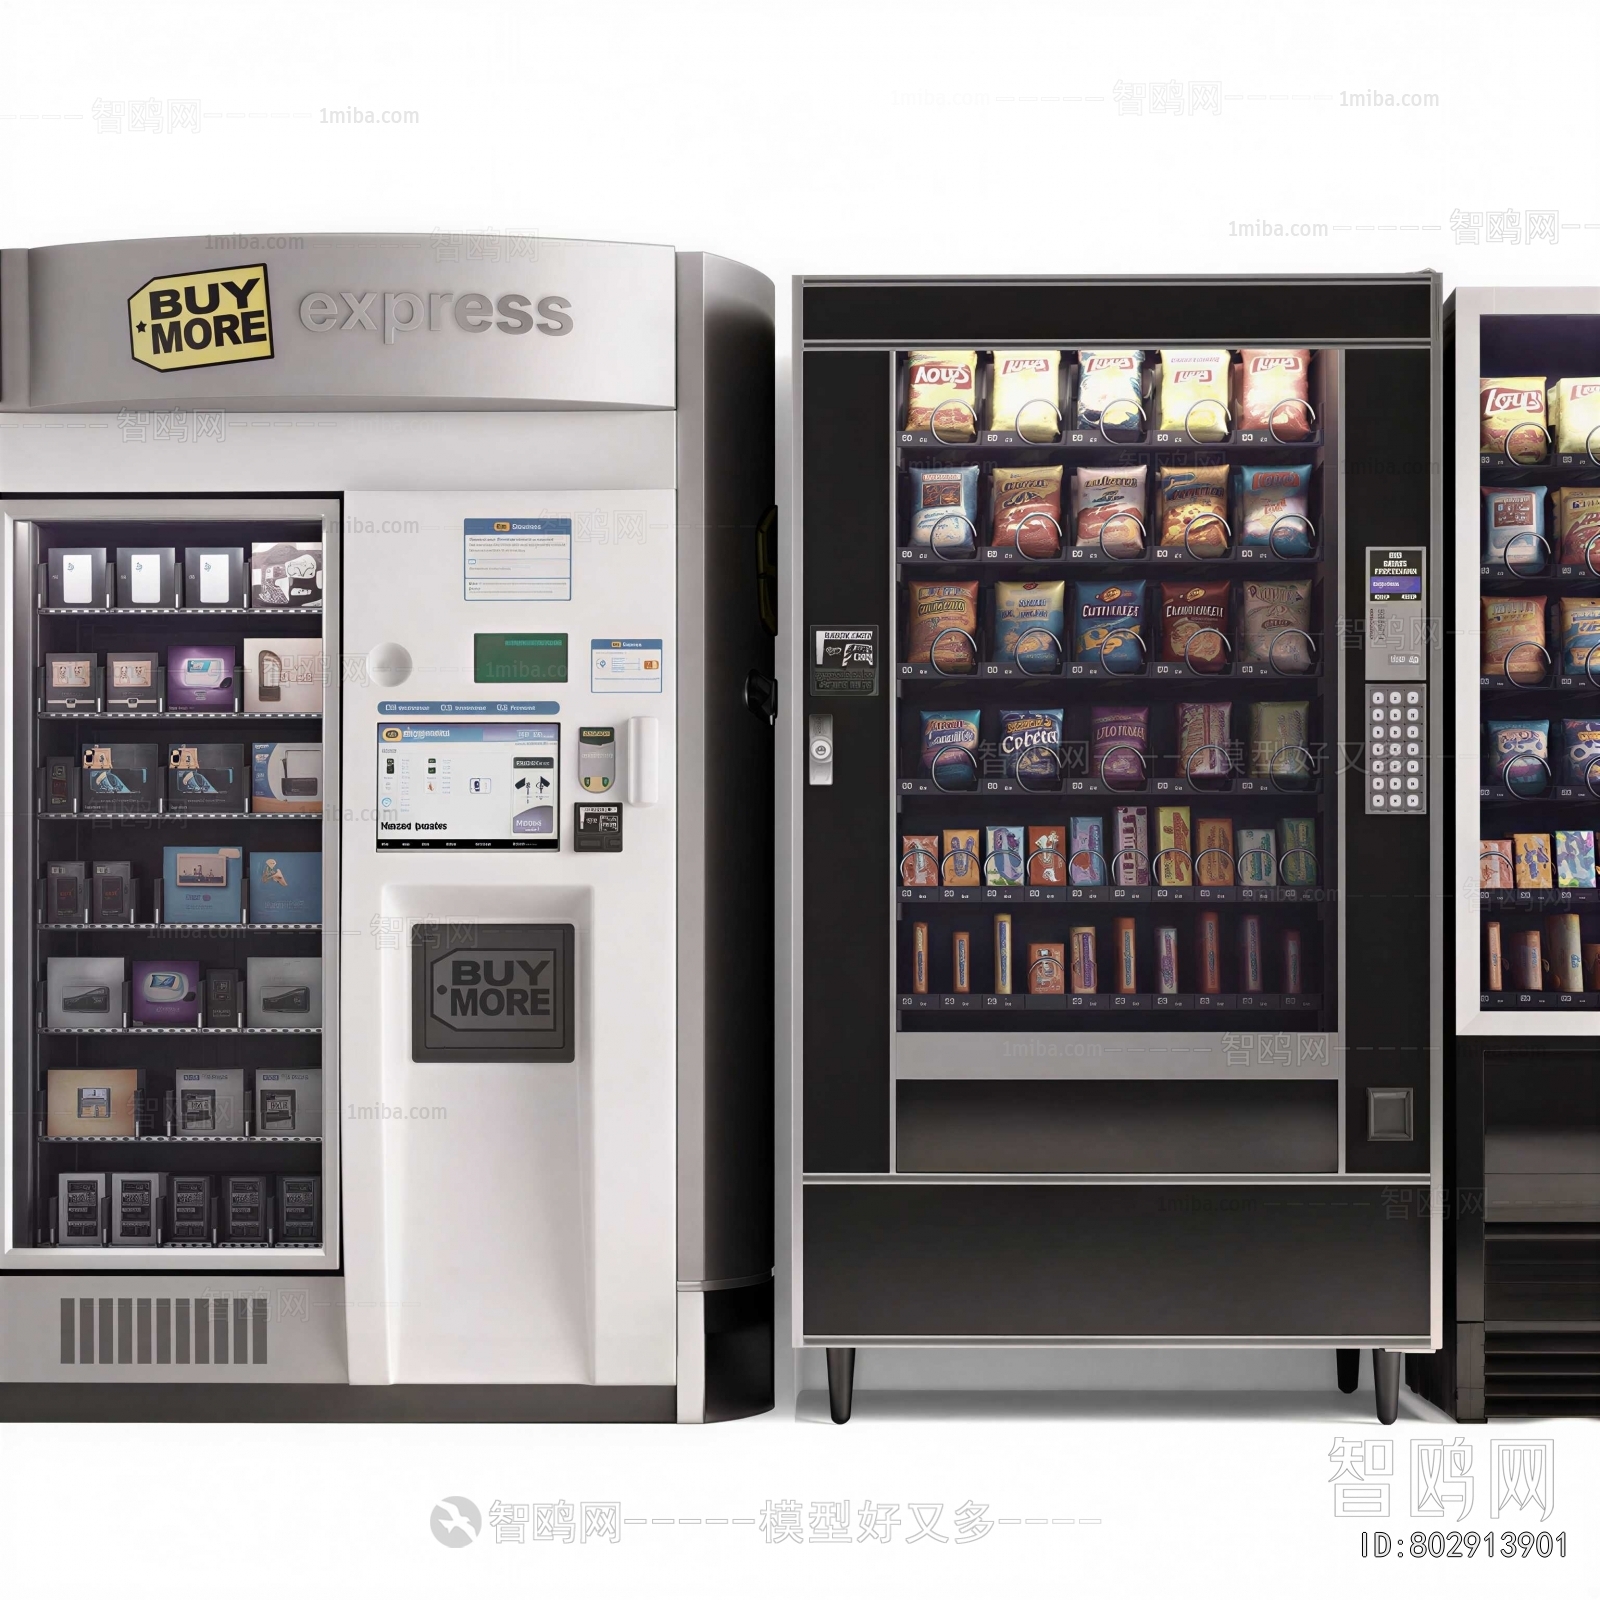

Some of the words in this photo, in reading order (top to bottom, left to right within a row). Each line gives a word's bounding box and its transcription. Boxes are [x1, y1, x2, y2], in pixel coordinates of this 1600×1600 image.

[150, 279, 260, 316] BUY
[299, 286, 574, 345] express
[151, 311, 267, 356] MORE
[452, 960, 550, 986] BUY
[450, 988, 551, 1016] MORE
